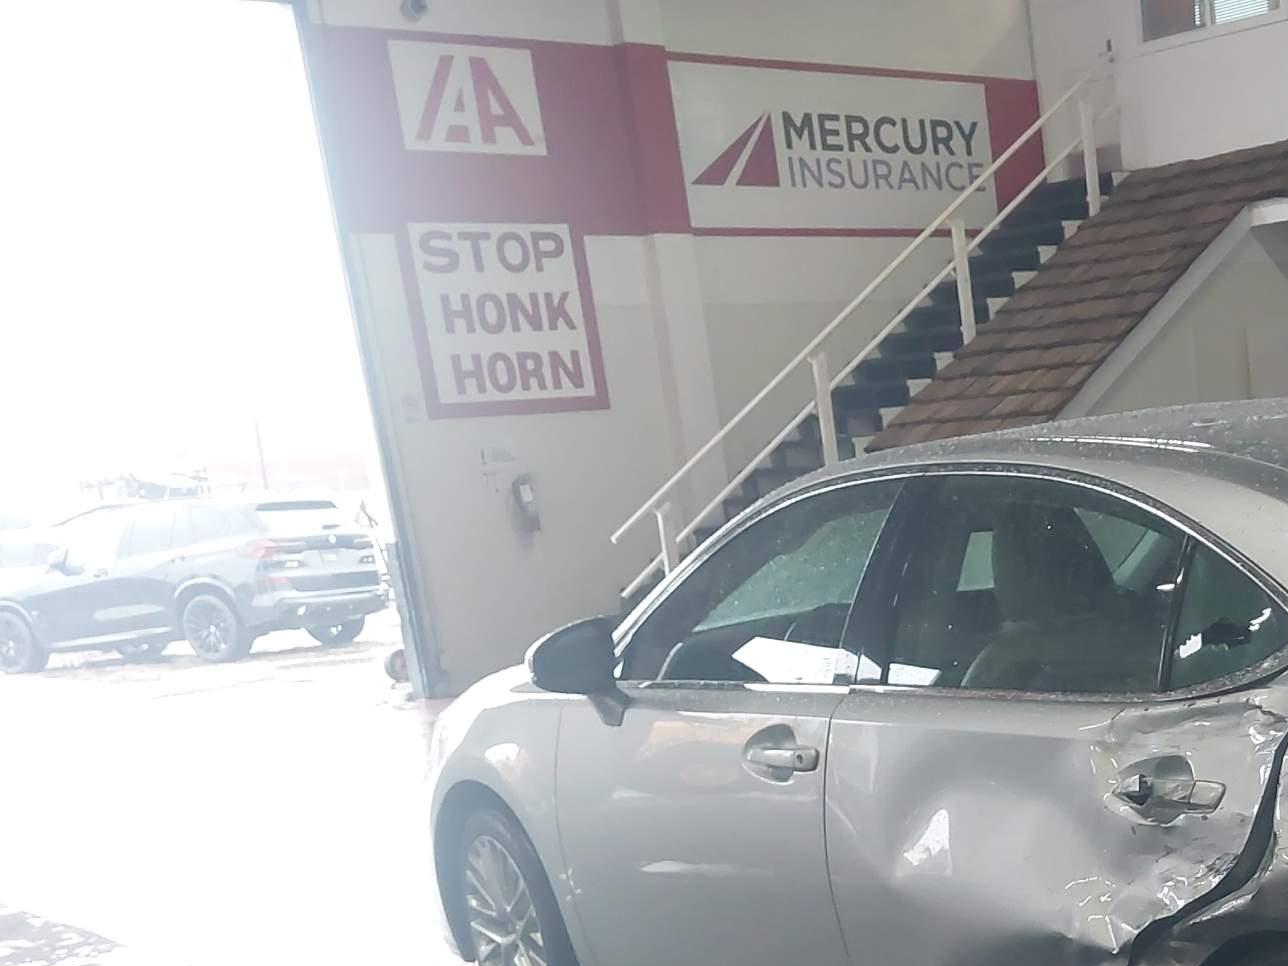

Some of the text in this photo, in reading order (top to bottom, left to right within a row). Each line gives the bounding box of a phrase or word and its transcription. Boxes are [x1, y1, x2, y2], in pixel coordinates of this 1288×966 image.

[782, 111, 978, 157] MERCURY
[788, 156, 986, 193] INSURANCE
[419, 230, 565, 274] STOP
[440, 291, 577, 335] HONK
[451, 350, 585, 396] HORN
